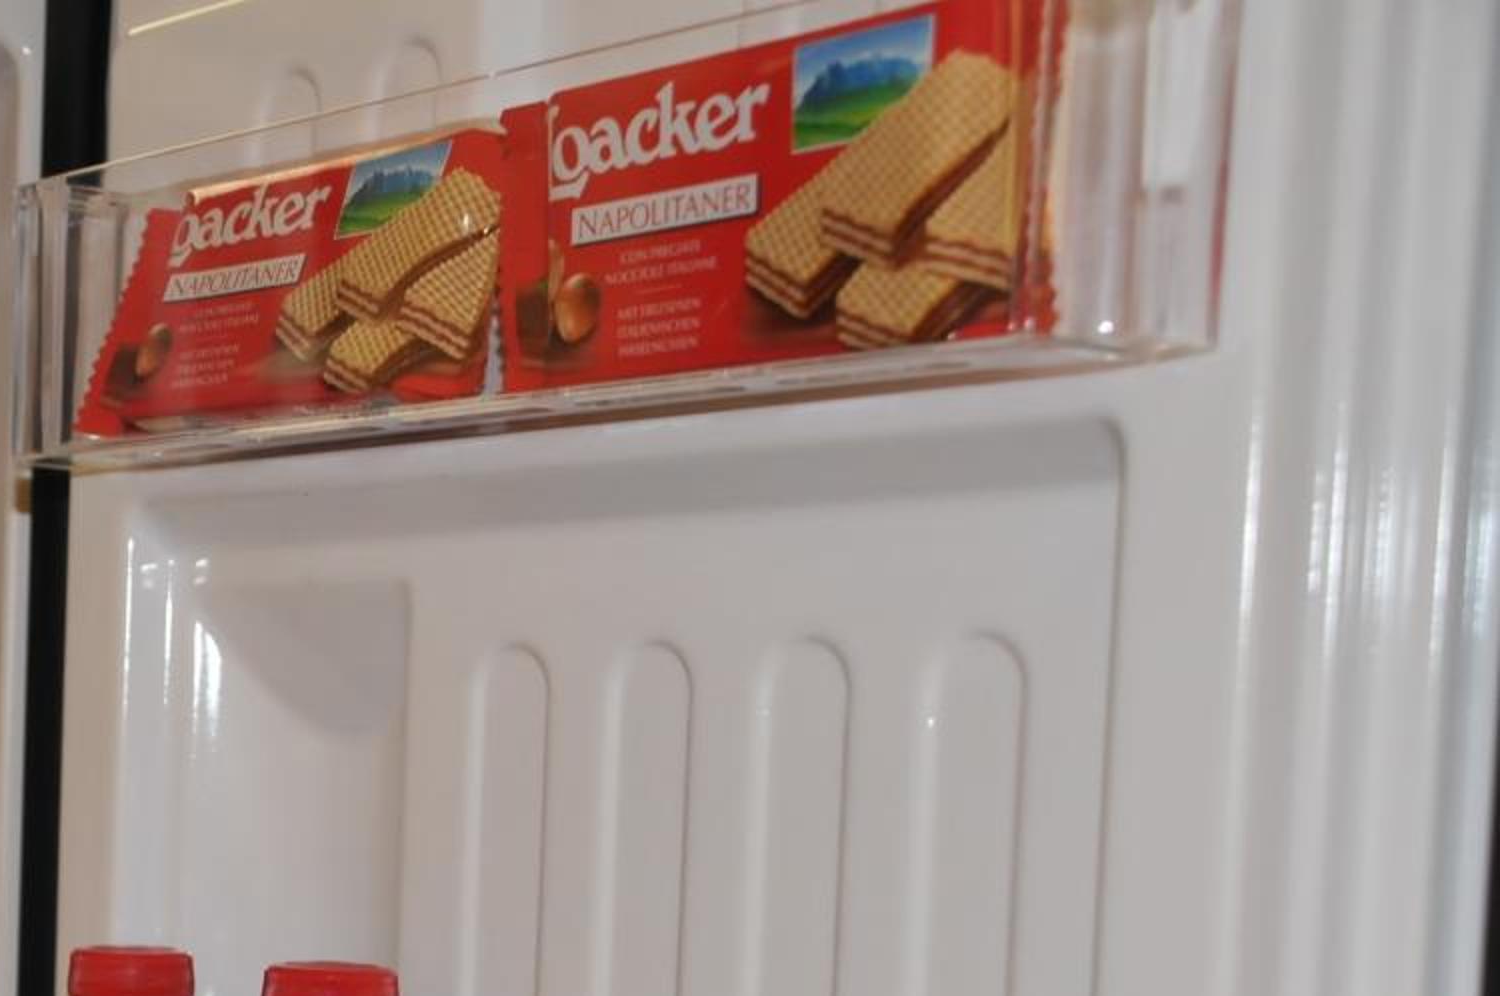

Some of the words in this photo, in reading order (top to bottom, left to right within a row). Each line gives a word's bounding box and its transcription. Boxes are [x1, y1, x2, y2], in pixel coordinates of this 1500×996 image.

[169, 178, 332, 268] oacker
[578, 182, 751, 240] NAPOLITANER
[171, 257, 301, 296] NAPOLITANER
